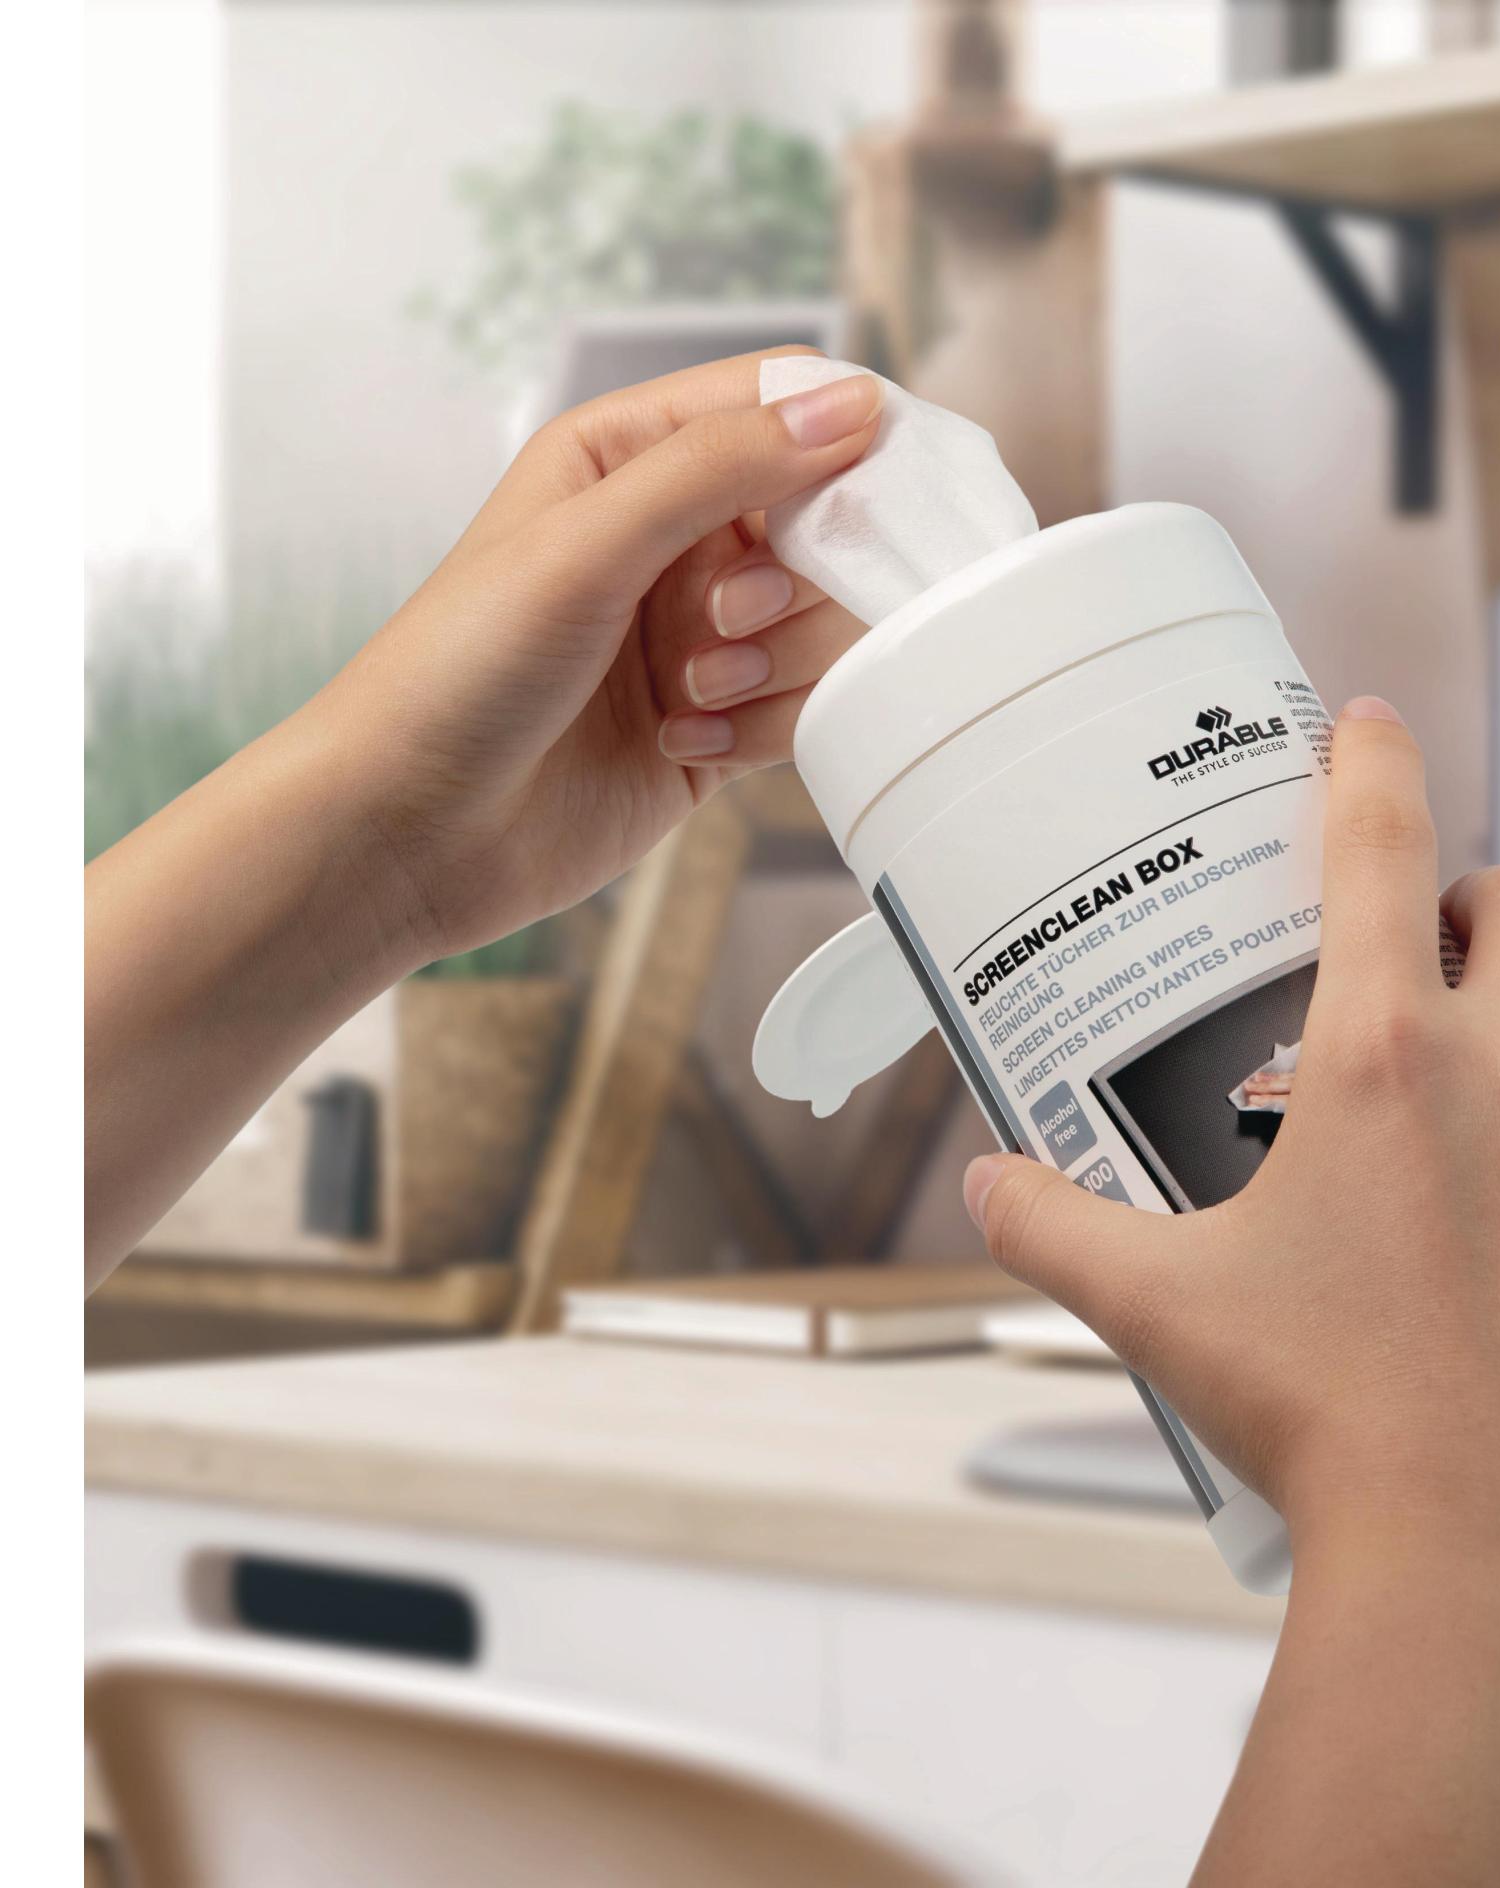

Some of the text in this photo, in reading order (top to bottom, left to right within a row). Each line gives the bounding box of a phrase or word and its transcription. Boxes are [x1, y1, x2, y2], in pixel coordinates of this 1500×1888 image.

[1147, 716, 1289, 780] DURABLE
[1171, 740, 1288, 787] THE STYLE OF SUCCESS
[963, 836, 1204, 1007] SCREENCLEAN BOX
[978, 838, 1290, 1032] FEUCHTE TÜCHER ZUR BILDSCHIRM-
[988, 982, 1065, 1050] REINIGUNG
[1002, 924, 1214, 1074] SCREEN CLEANING WIPES
[1014, 1031, 1089, 1099] LINGETTES
[1087, 948, 1229, 1040] NETTOYANTES
[1229, 919, 1289, 957] POUR
[1040, 1097, 1079, 1138] Alcohol
[1054, 1124, 1078, 1148] free
[1083, 1162, 1114, 1195] 100
